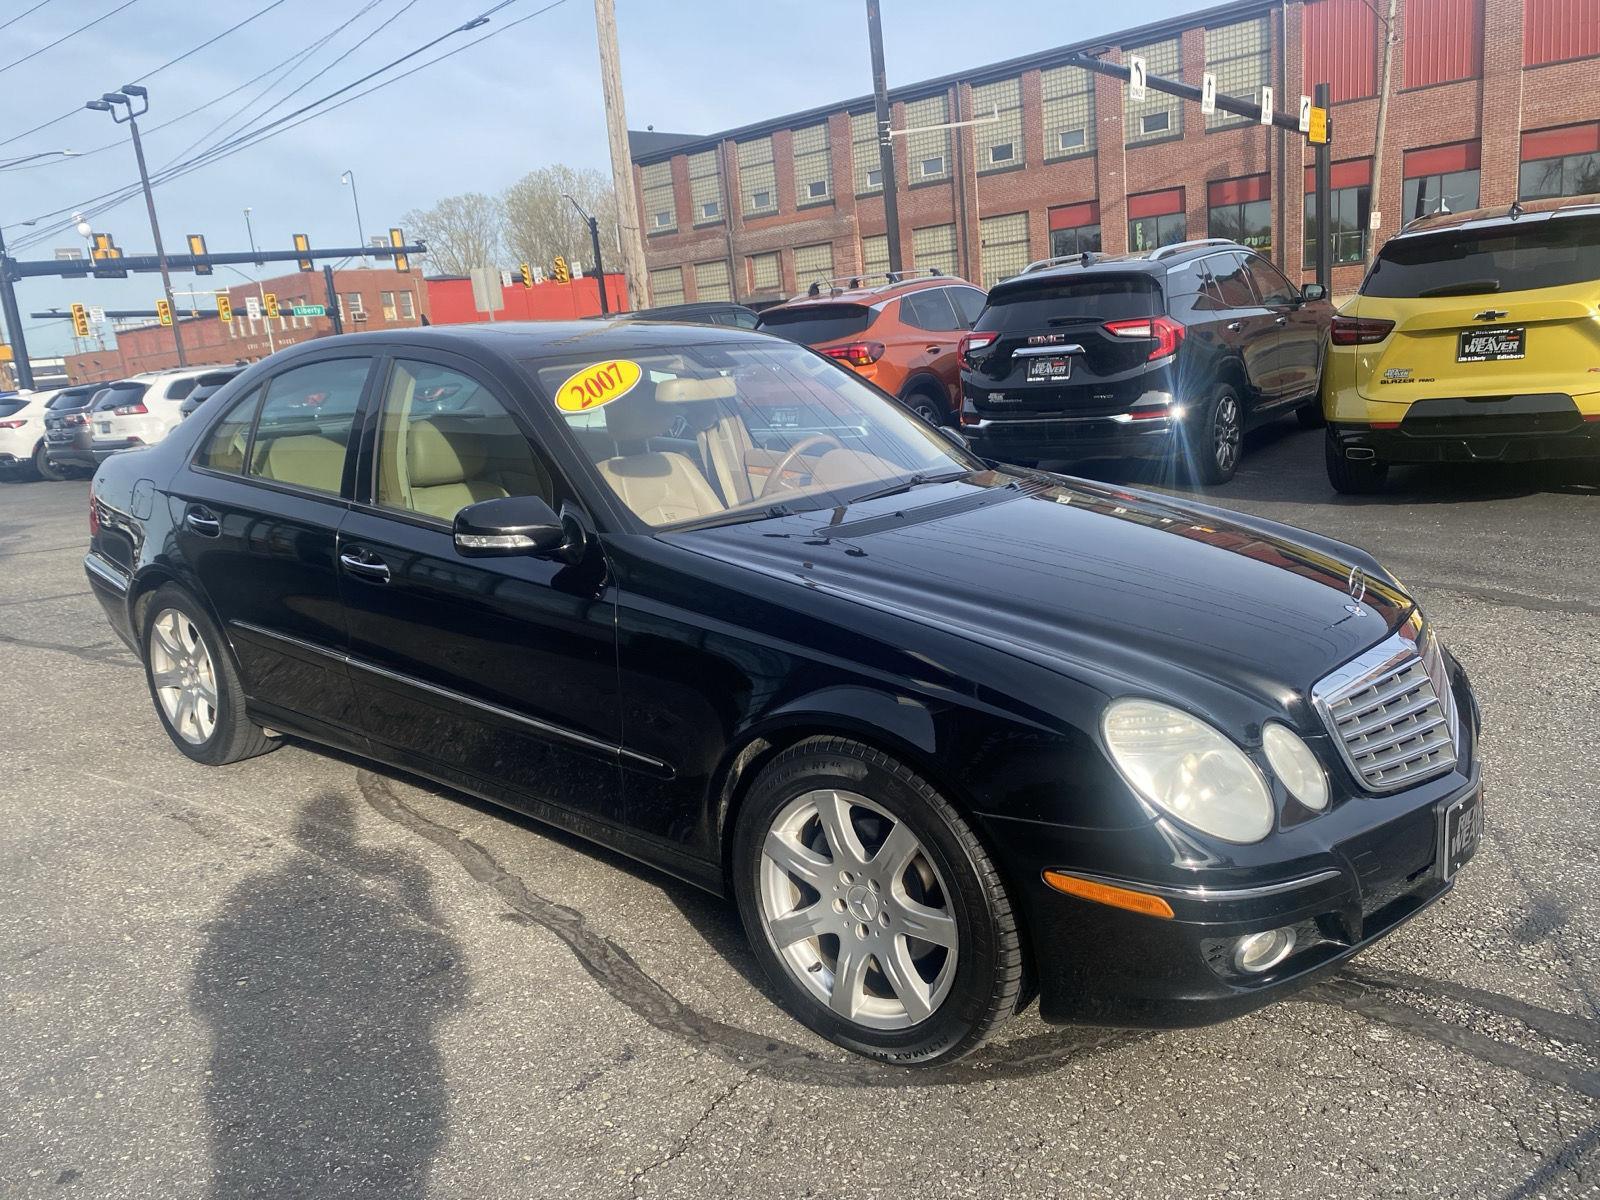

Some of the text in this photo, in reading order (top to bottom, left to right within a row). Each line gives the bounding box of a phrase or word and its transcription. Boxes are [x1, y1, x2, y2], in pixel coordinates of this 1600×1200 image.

[297, 307, 321, 315] Liberty
[1028, 334, 1064, 344] GMC
[1471, 336, 1497, 345] RICK
[1465, 341, 1519, 353] WEAVER
[1032, 366, 1066, 374] WEAVER
[570, 362, 623, 408] 2007
